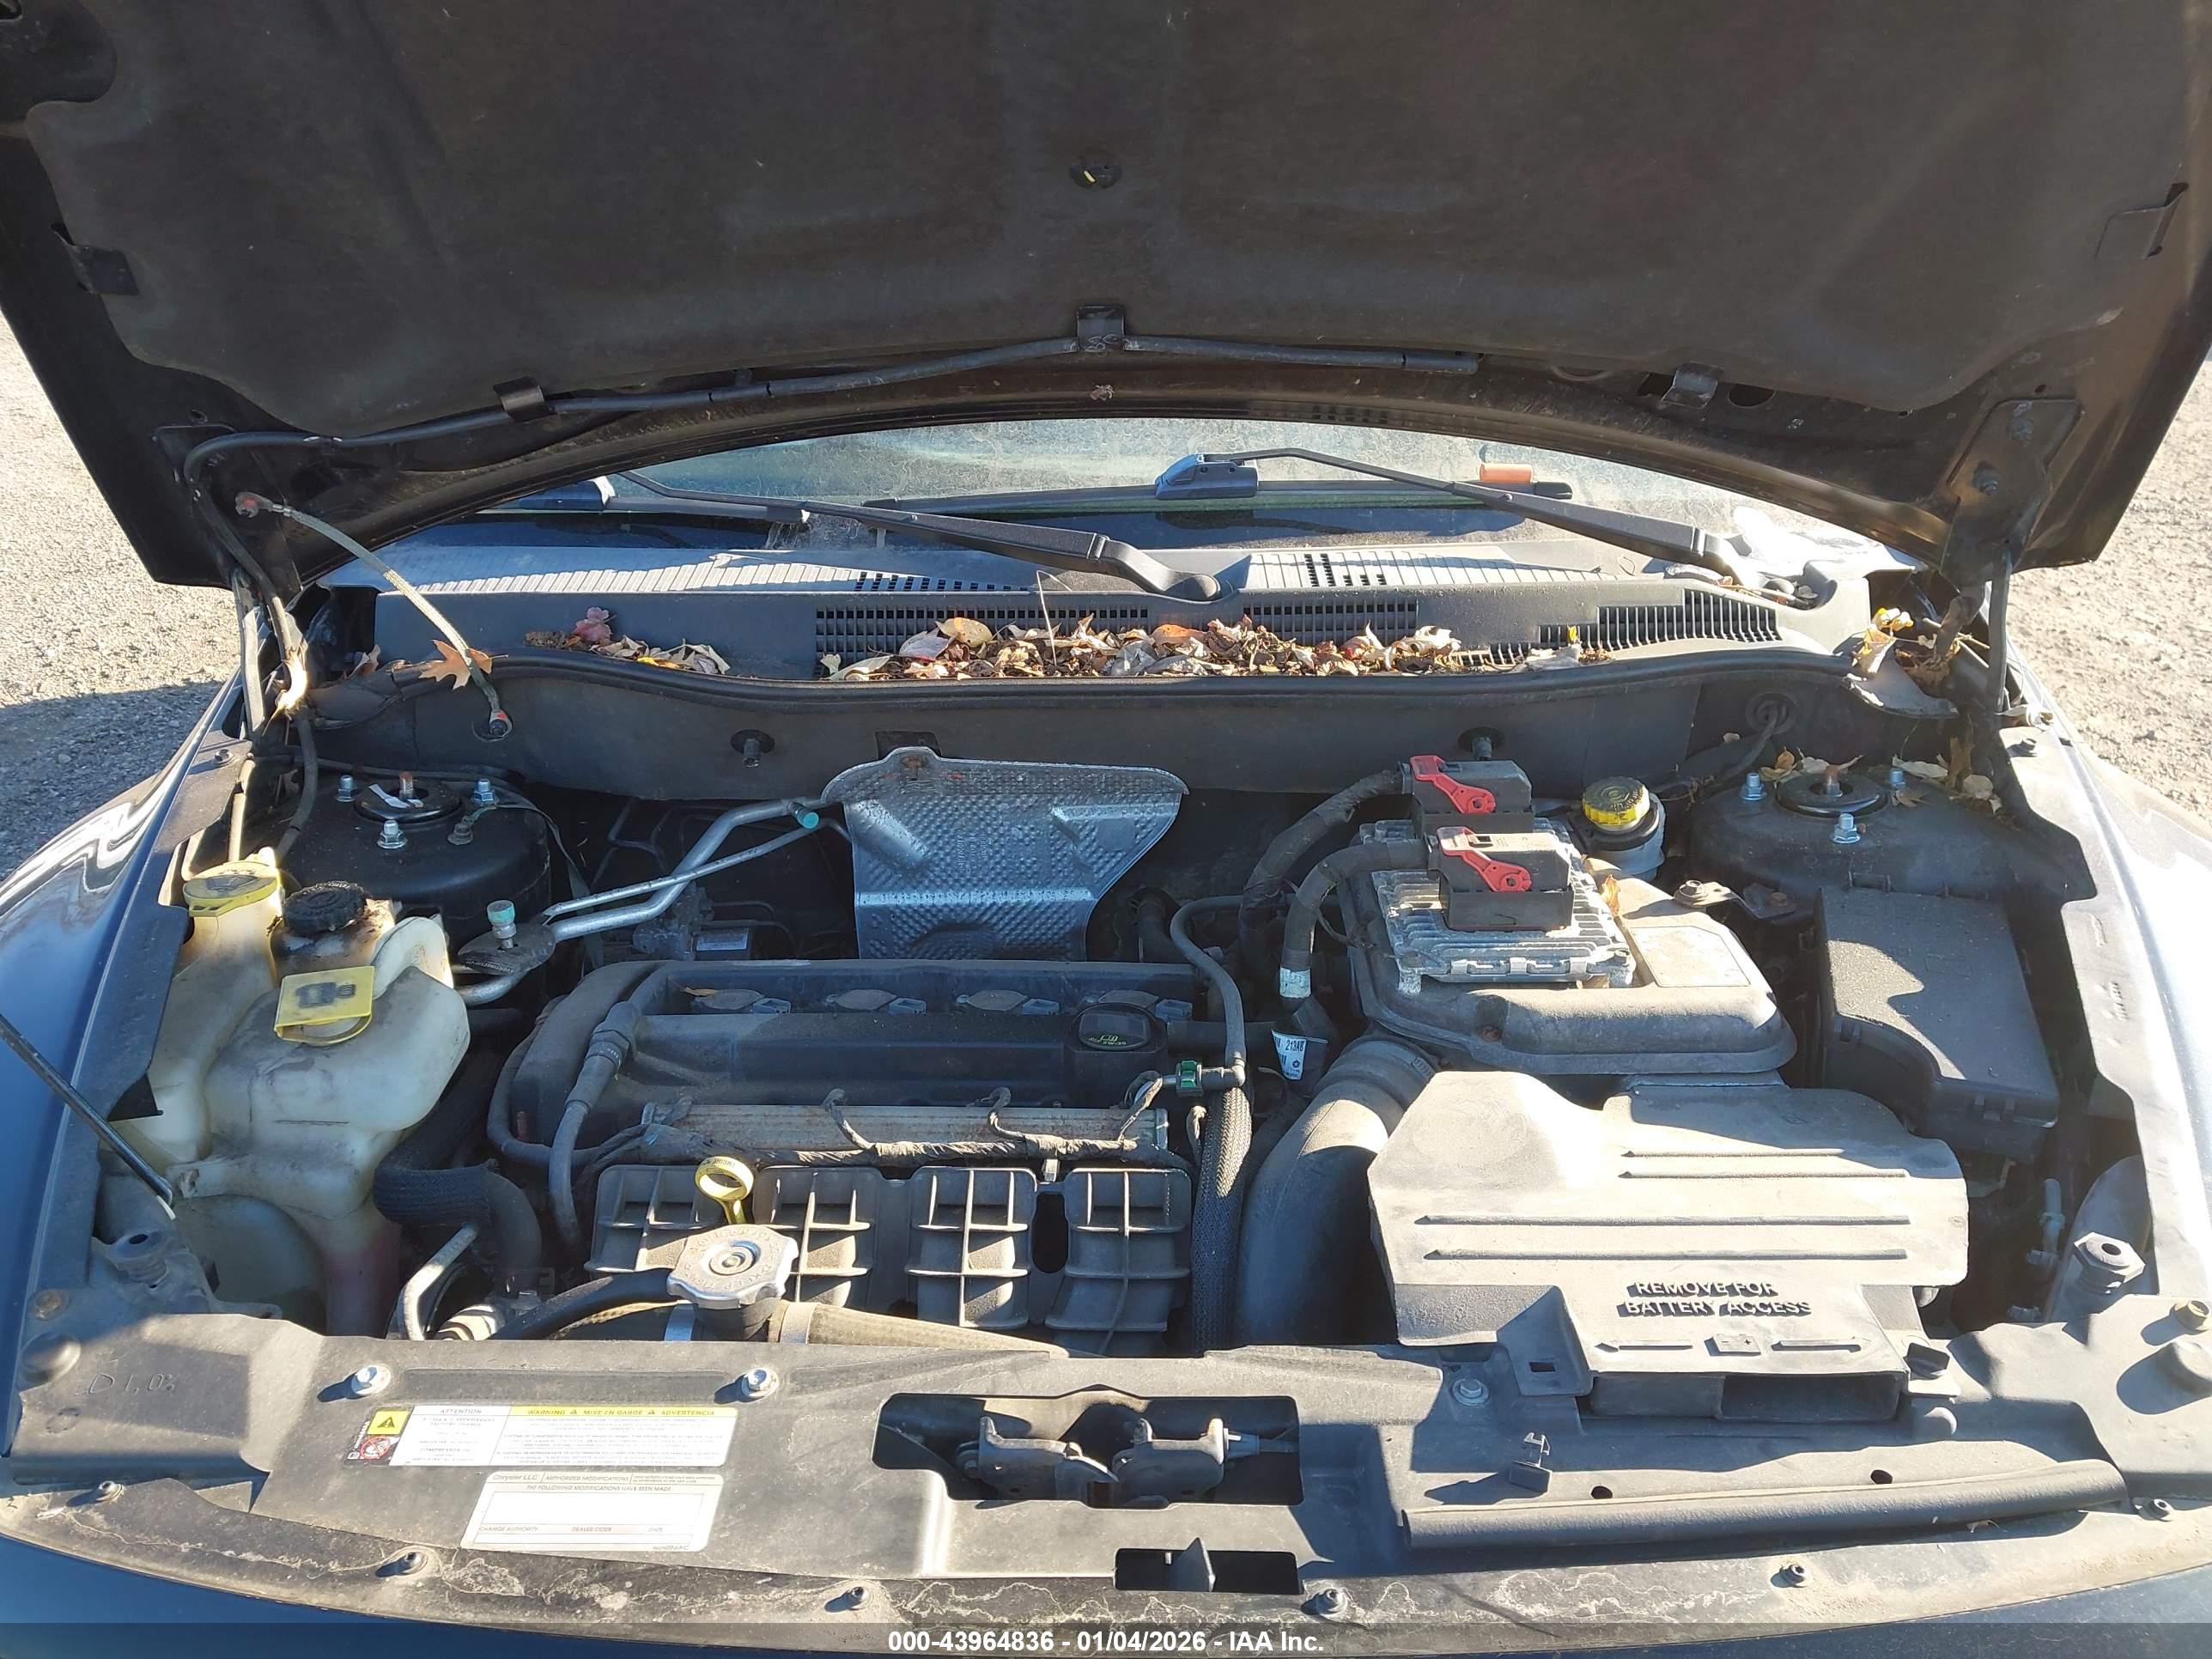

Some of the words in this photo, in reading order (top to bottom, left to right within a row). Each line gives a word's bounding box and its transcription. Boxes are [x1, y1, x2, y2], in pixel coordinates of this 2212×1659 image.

[1627, 1282, 1729, 1297] REMOVE
[1729, 1282, 1778, 1297] FOR
[1617, 1301, 1716, 1317] BATTERY
[1719, 1301, 1812, 1317] ACCESS
